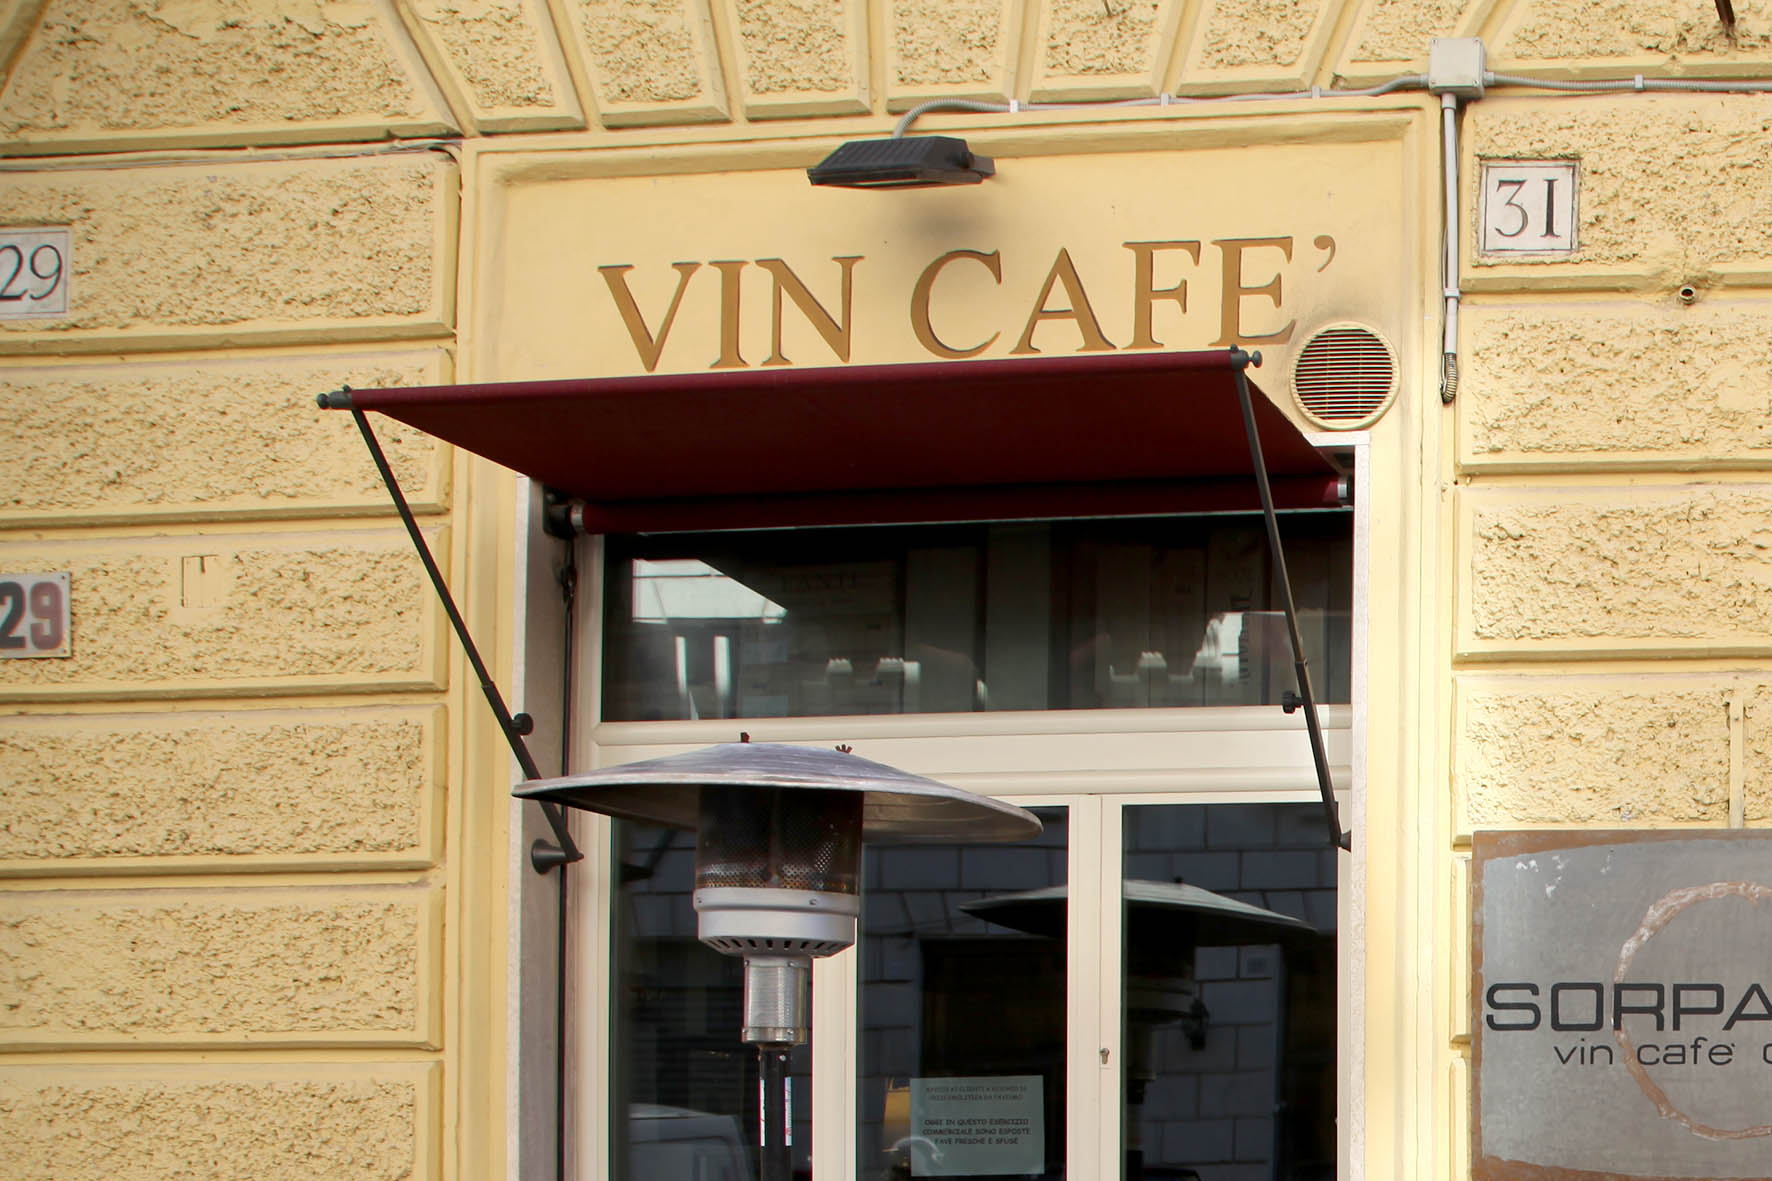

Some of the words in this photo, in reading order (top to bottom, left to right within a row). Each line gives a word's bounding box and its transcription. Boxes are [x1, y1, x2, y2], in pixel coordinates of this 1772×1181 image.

[1495, 178, 1562, 240] 31
[0, 244, 63, 300] 29
[598, 256, 864, 371] VIN
[0, 581, 62, 650] 29
[1553, 1037, 1613, 1066] vin
[957, 1118, 987, 1126] QUESTO
